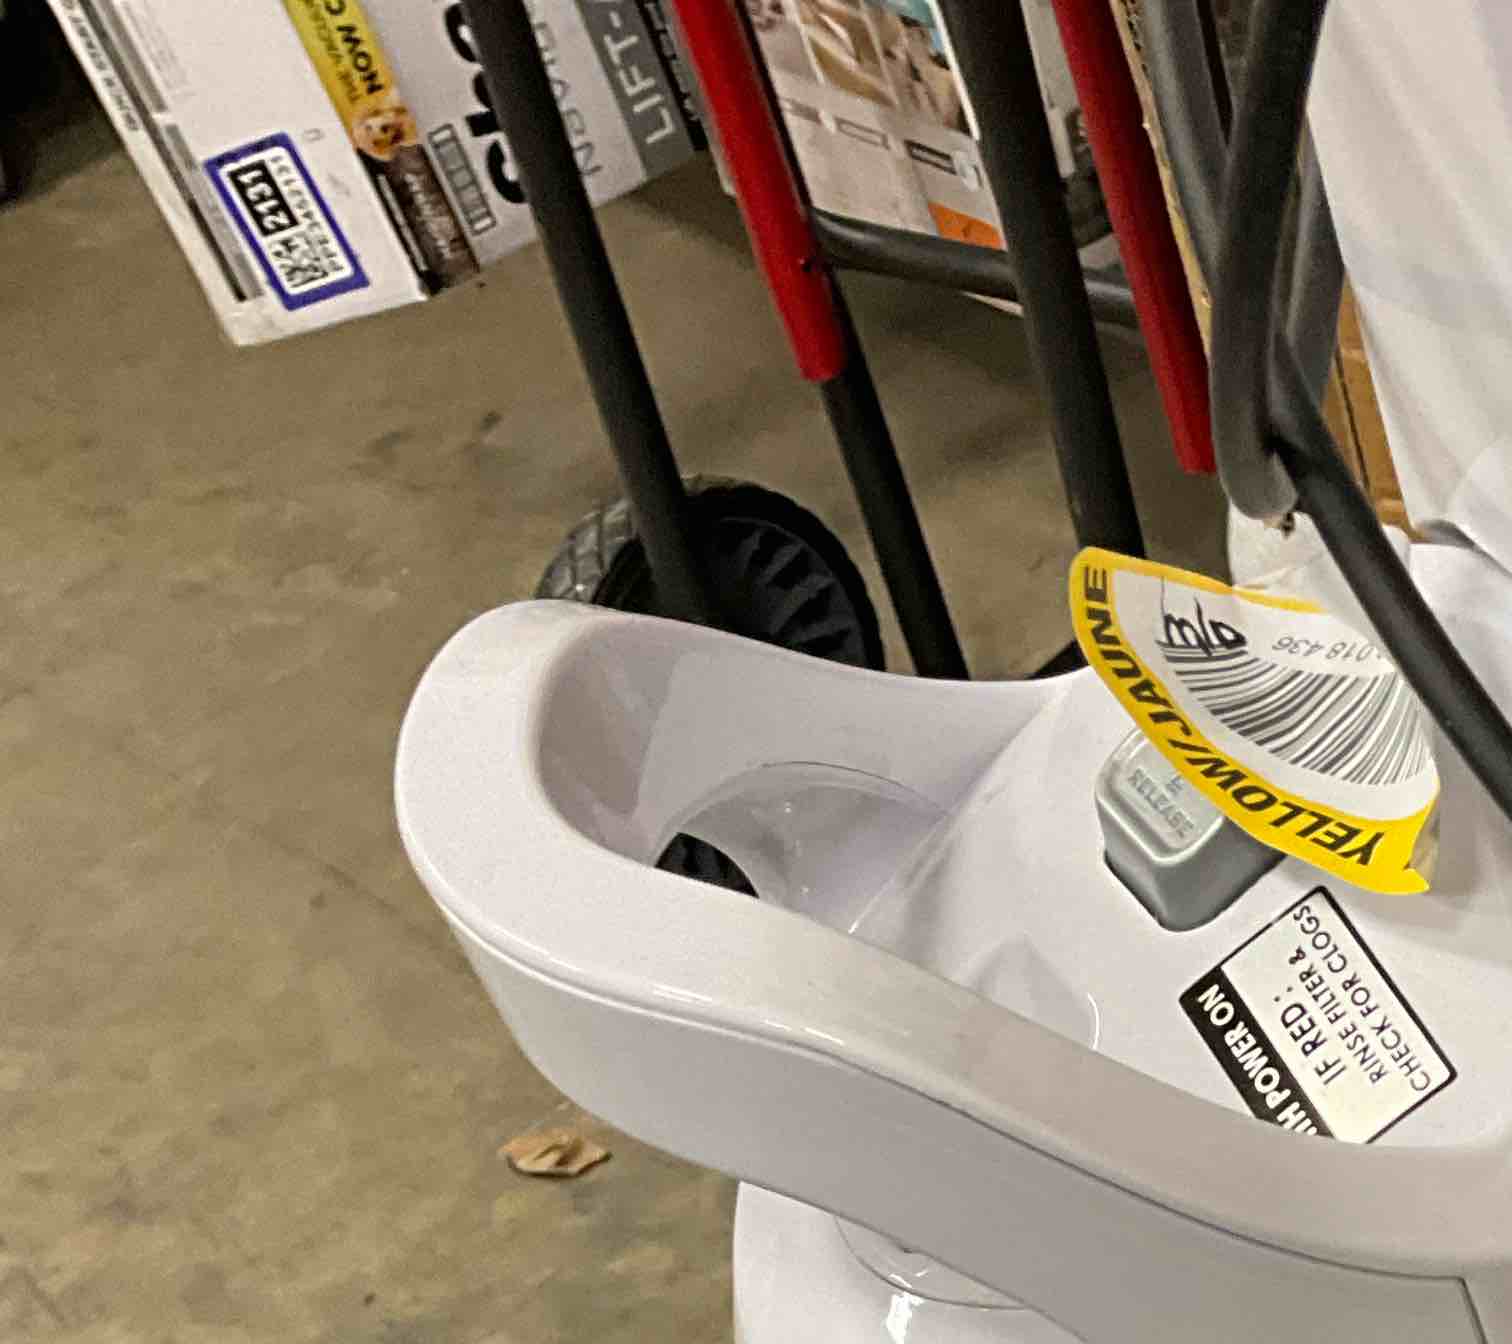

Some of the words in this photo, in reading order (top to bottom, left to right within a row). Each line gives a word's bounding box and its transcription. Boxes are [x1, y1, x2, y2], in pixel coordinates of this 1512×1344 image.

[335, 26, 385, 96] NOW
[237, 168, 292, 231] 2131
[1272, 634, 1324, 658] 436
[1083, 565, 1386, 866] YELLOW/JAUNE
[1287, 946, 1306, 966] &
[1292, 905, 1348, 974] CLOGS
[1198, 985, 1236, 1026] ON
[1299, 964, 1346, 1024] FILTER
[1340, 973, 1379, 1017] FOR
[1223, 1021, 1291, 1109] POWER
[1313, 1053, 1346, 1084] IF
[1339, 1023, 1387, 1083] RINSE
[1371, 1016, 1430, 1092] CHECK
